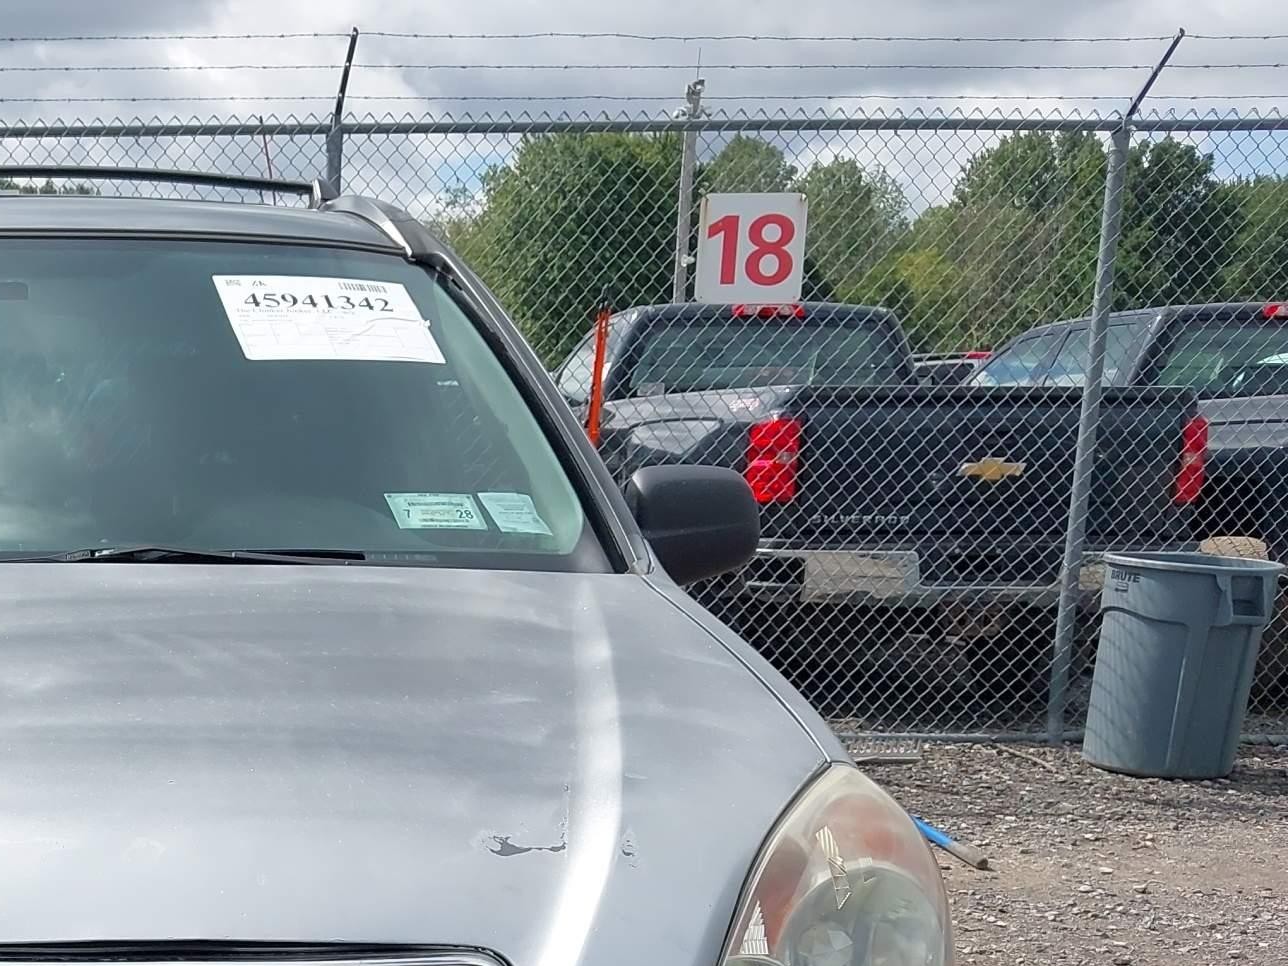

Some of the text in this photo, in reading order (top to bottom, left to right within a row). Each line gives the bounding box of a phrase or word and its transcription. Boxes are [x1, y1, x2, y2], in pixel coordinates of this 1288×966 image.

[707, 212, 796, 287] 18
[244, 292, 394, 313] 45941342
[455, 509, 474, 519] 28
